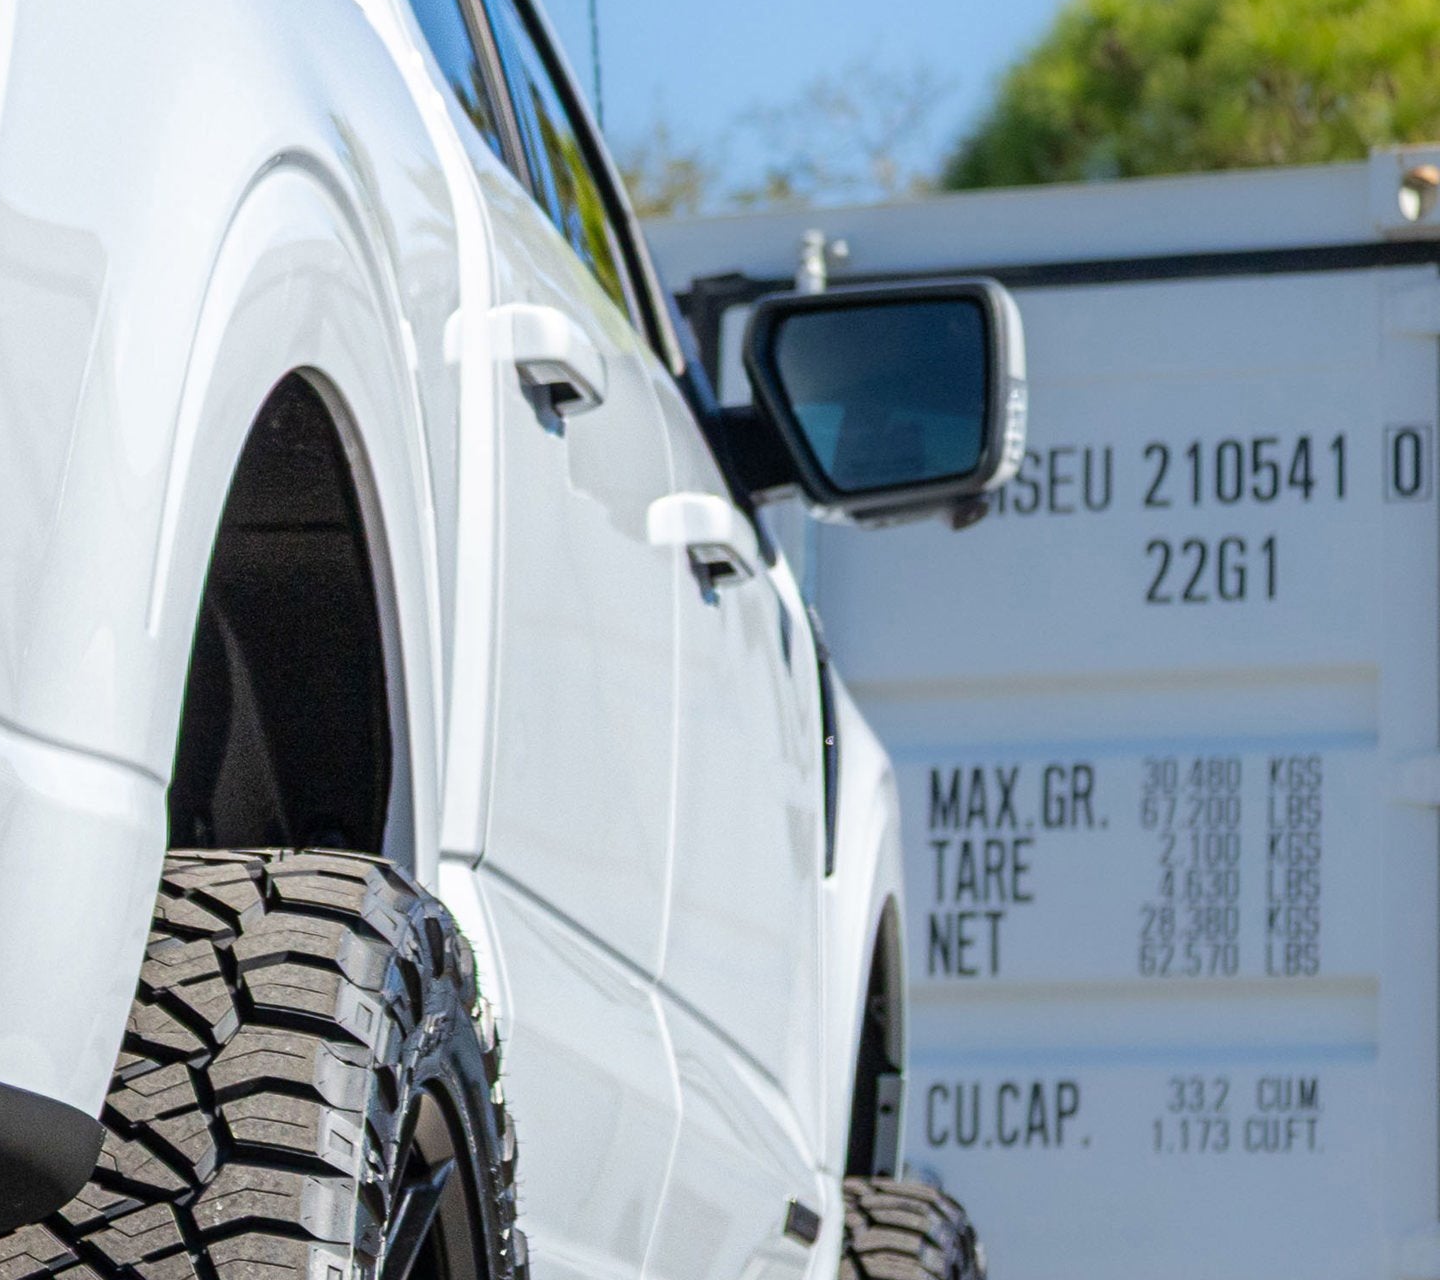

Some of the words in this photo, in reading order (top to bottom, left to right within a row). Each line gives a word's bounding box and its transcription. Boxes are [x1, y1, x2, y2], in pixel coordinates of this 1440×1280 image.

[996, 441, 1114, 518] SEU
[1142, 432, 1348, 510] 210541
[1144, 533, 1278, 606] 22G1
[927, 761, 1110, 831] MAX.GR.
[1267, 756, 1324, 793] KGS
[1267, 794, 1323, 830] LBS
[930, 836, 1035, 905] TARE
[1266, 832, 1322, 867] KGS
[1266, 868, 1321, 904] LBS
[927, 908, 1008, 979] NET
[1266, 905, 1321, 941] KGS
[1265, 942, 1320, 977] LBS
[925, 1078, 1092, 1150] CU.CAP.
